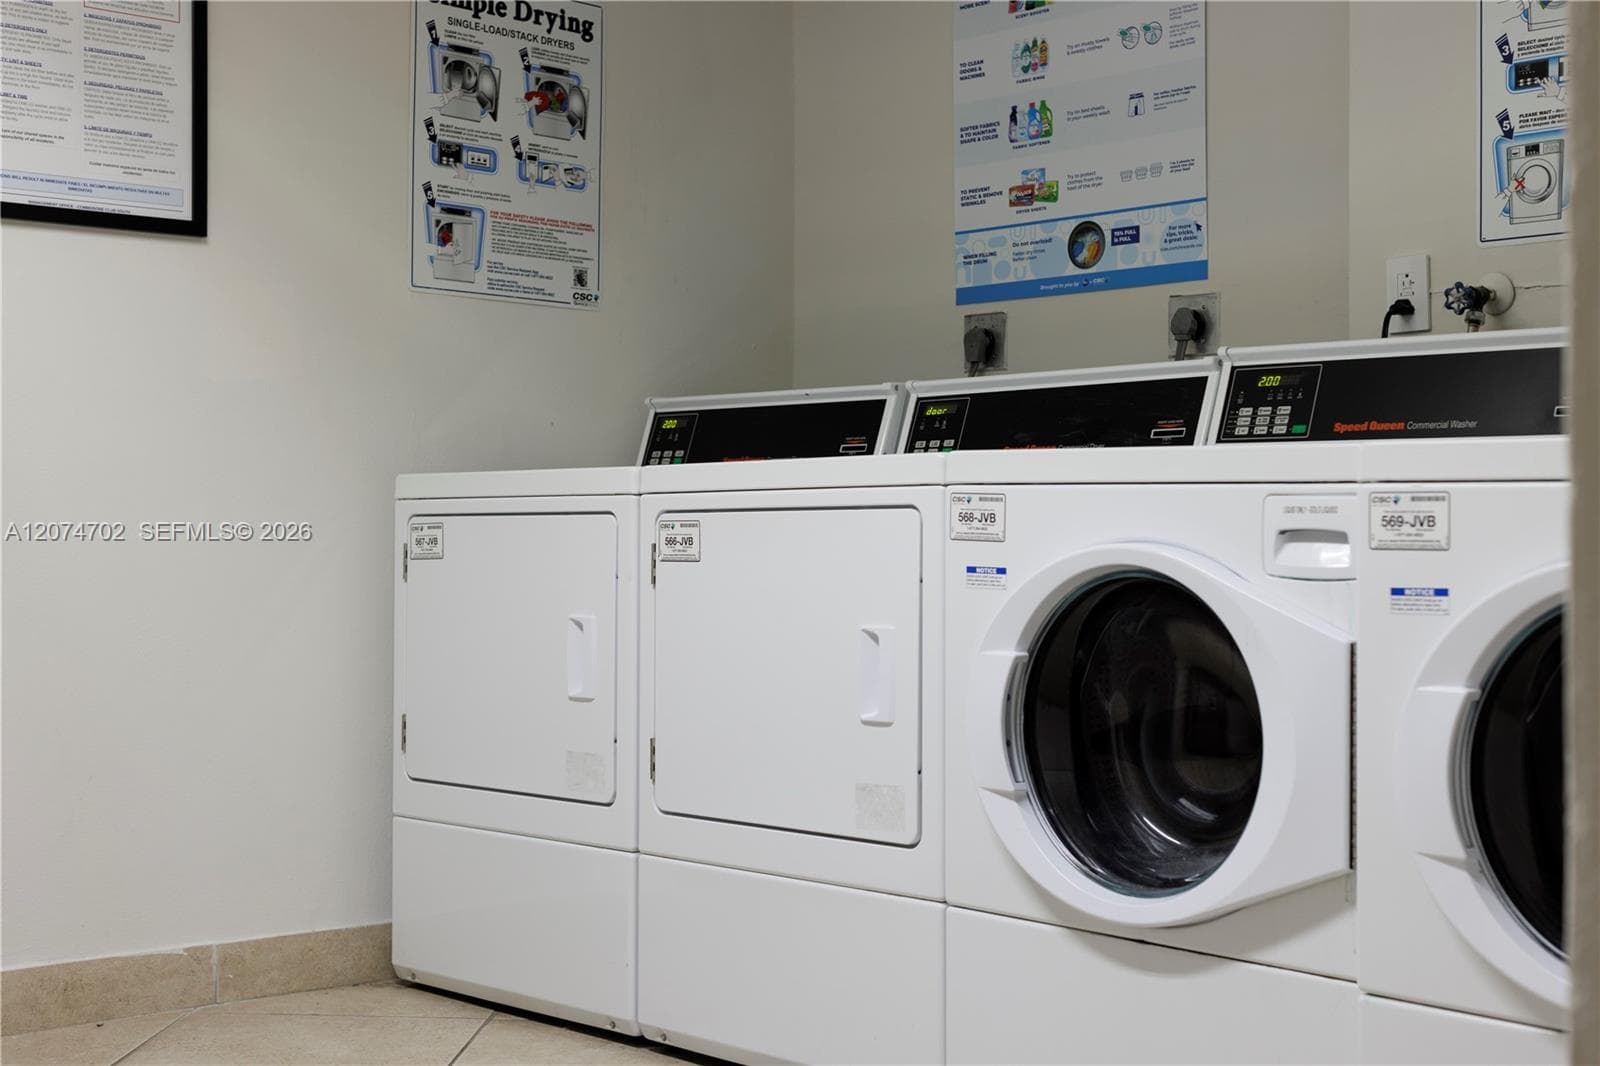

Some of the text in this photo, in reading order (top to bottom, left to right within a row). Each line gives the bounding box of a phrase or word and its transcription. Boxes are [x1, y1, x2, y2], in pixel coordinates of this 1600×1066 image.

[513, 0, 594, 42] Drying
[447, 16, 575, 50] SINGLE-LOAD/STACK DRYERS
[1502, 45, 1510, 56] 3
[1517, 42, 1549, 52] SELECCIONE
[1519, 111, 1538, 119] PLEASE
[979, 121, 1000, 129] FABRICS
[1503, 121, 1510, 131] 5
[428, 126, 435, 136] 3
[968, 186, 990, 194] PREVENT
[960, 193, 978, 201] STATIC
[573, 291, 593, 302] CSC
[1333, 419, 1478, 433] Speed Queen Commercial Washer
[958, 512, 996, 523] 568-JVB
[1381, 515, 1436, 527] 569-JVB
[664, 536, 694, 546] 566-JVB
